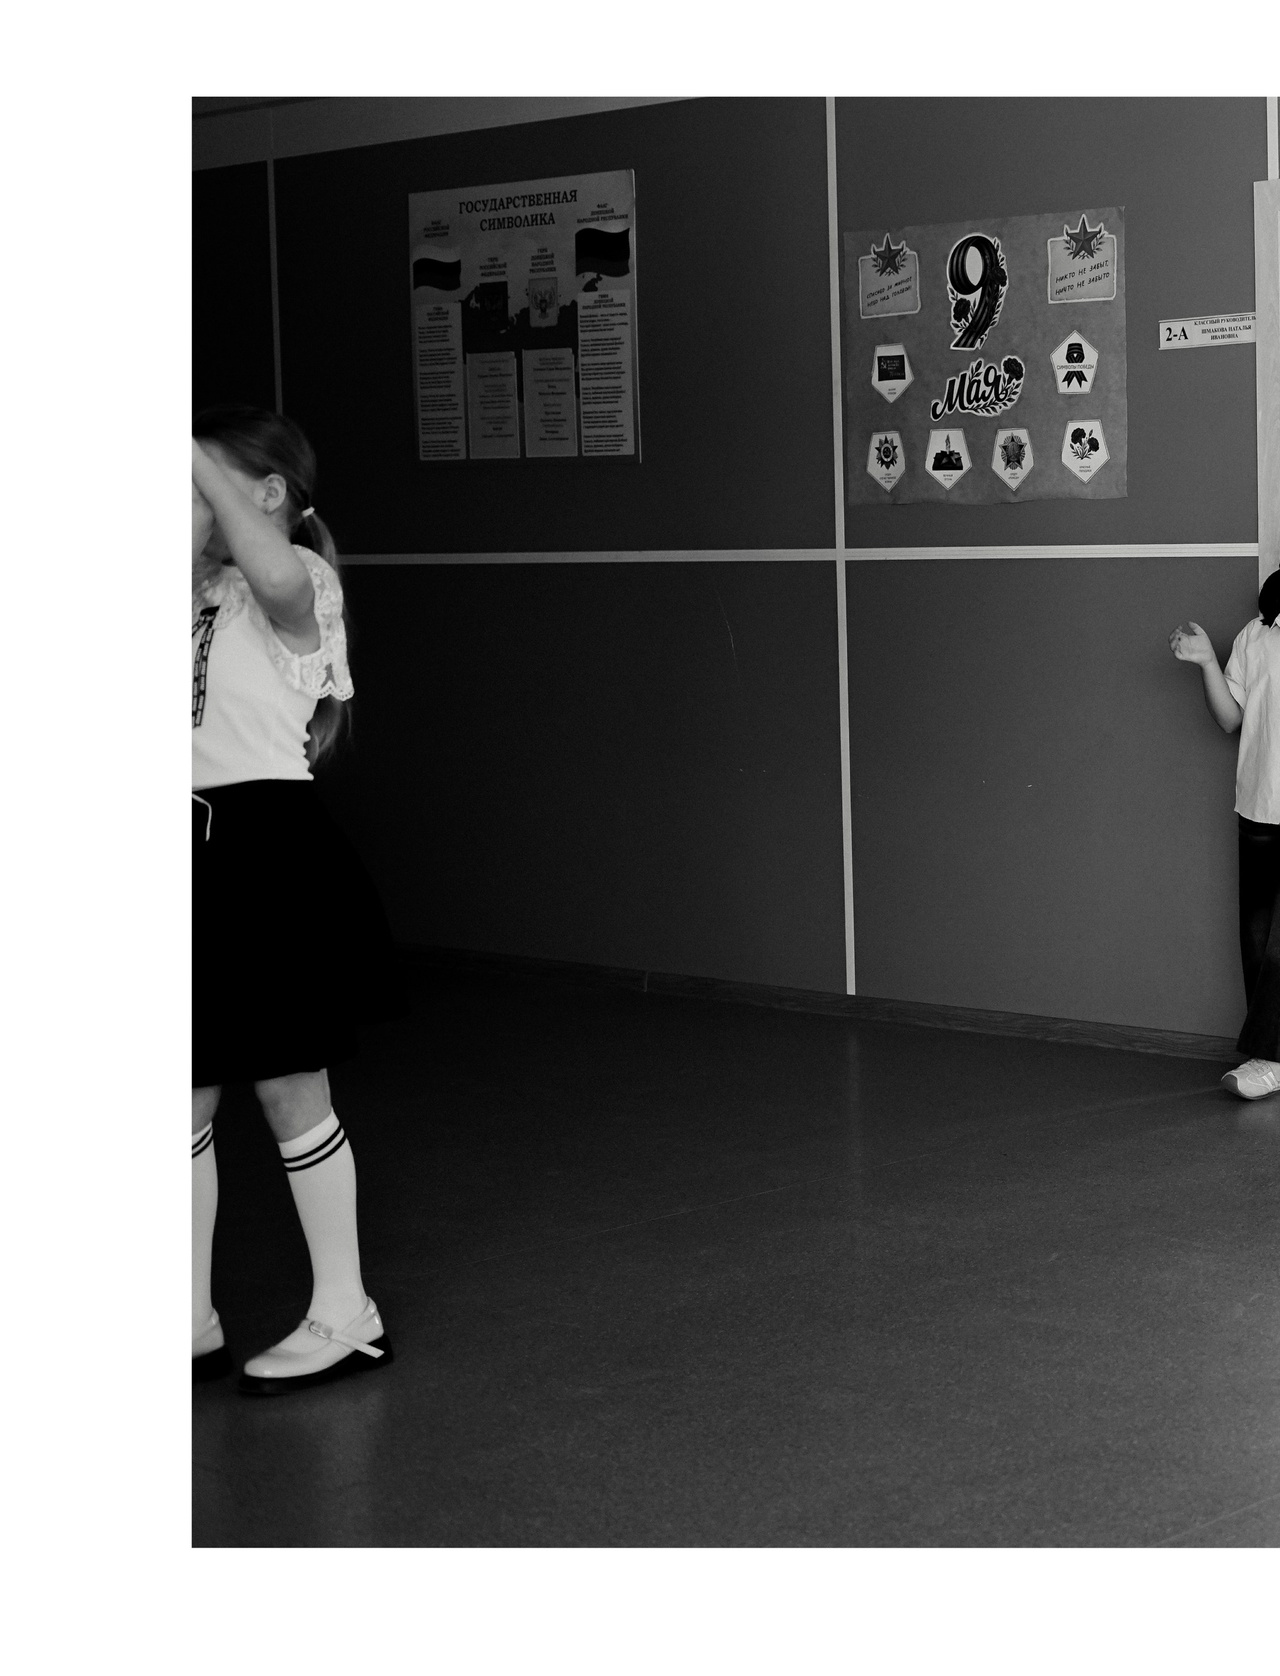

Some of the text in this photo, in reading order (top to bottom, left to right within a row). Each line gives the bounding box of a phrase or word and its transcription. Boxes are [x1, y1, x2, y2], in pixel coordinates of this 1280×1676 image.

[459, 189, 578, 214] ГОСУДАРСТВЕННАЯ
[479, 212, 556, 231] СИМВОЛИКА
[1078, 267, 1086, 275] НЕ
[950, 235, 1000, 348] 9
[1077, 280, 1085, 288] НЕ
[931, 365, 1008, 419] Мая
